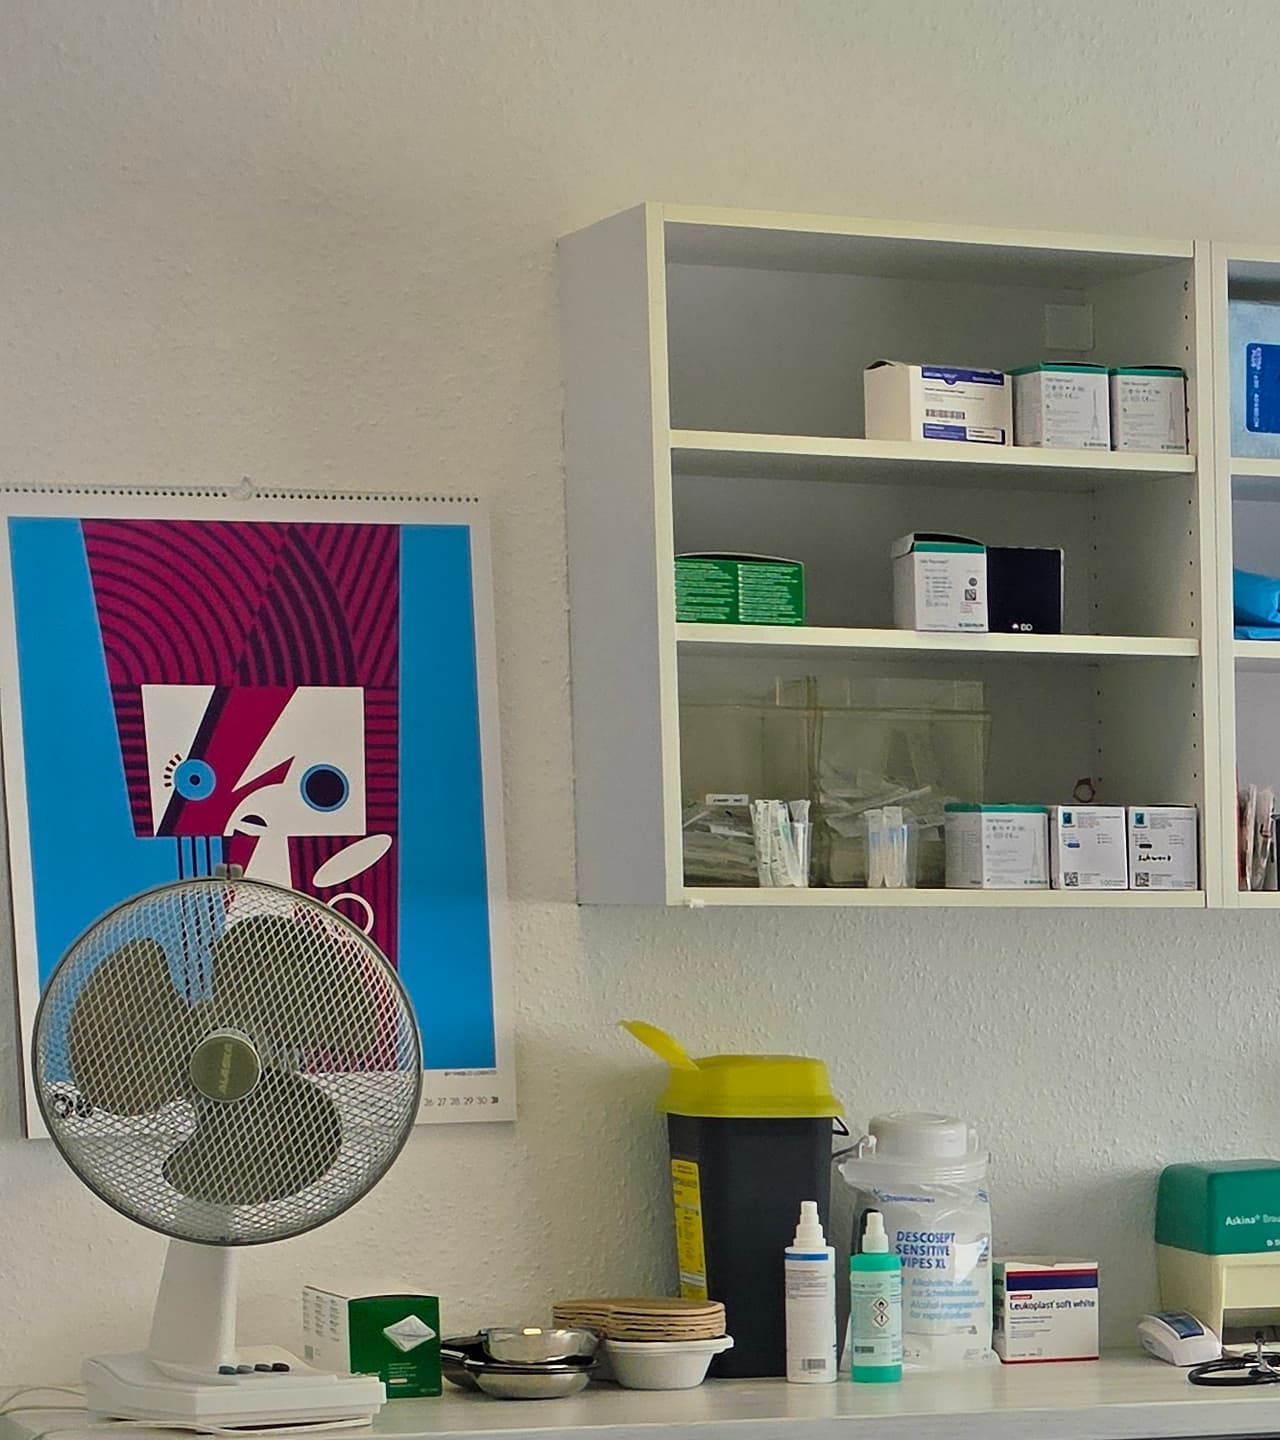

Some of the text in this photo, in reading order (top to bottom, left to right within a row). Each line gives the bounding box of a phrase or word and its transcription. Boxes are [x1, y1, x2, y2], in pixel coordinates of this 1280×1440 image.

[896, 1231, 955, 1244] DESCOSEPT
[1010, 1299, 1095, 1311] Leukoplast soft white
